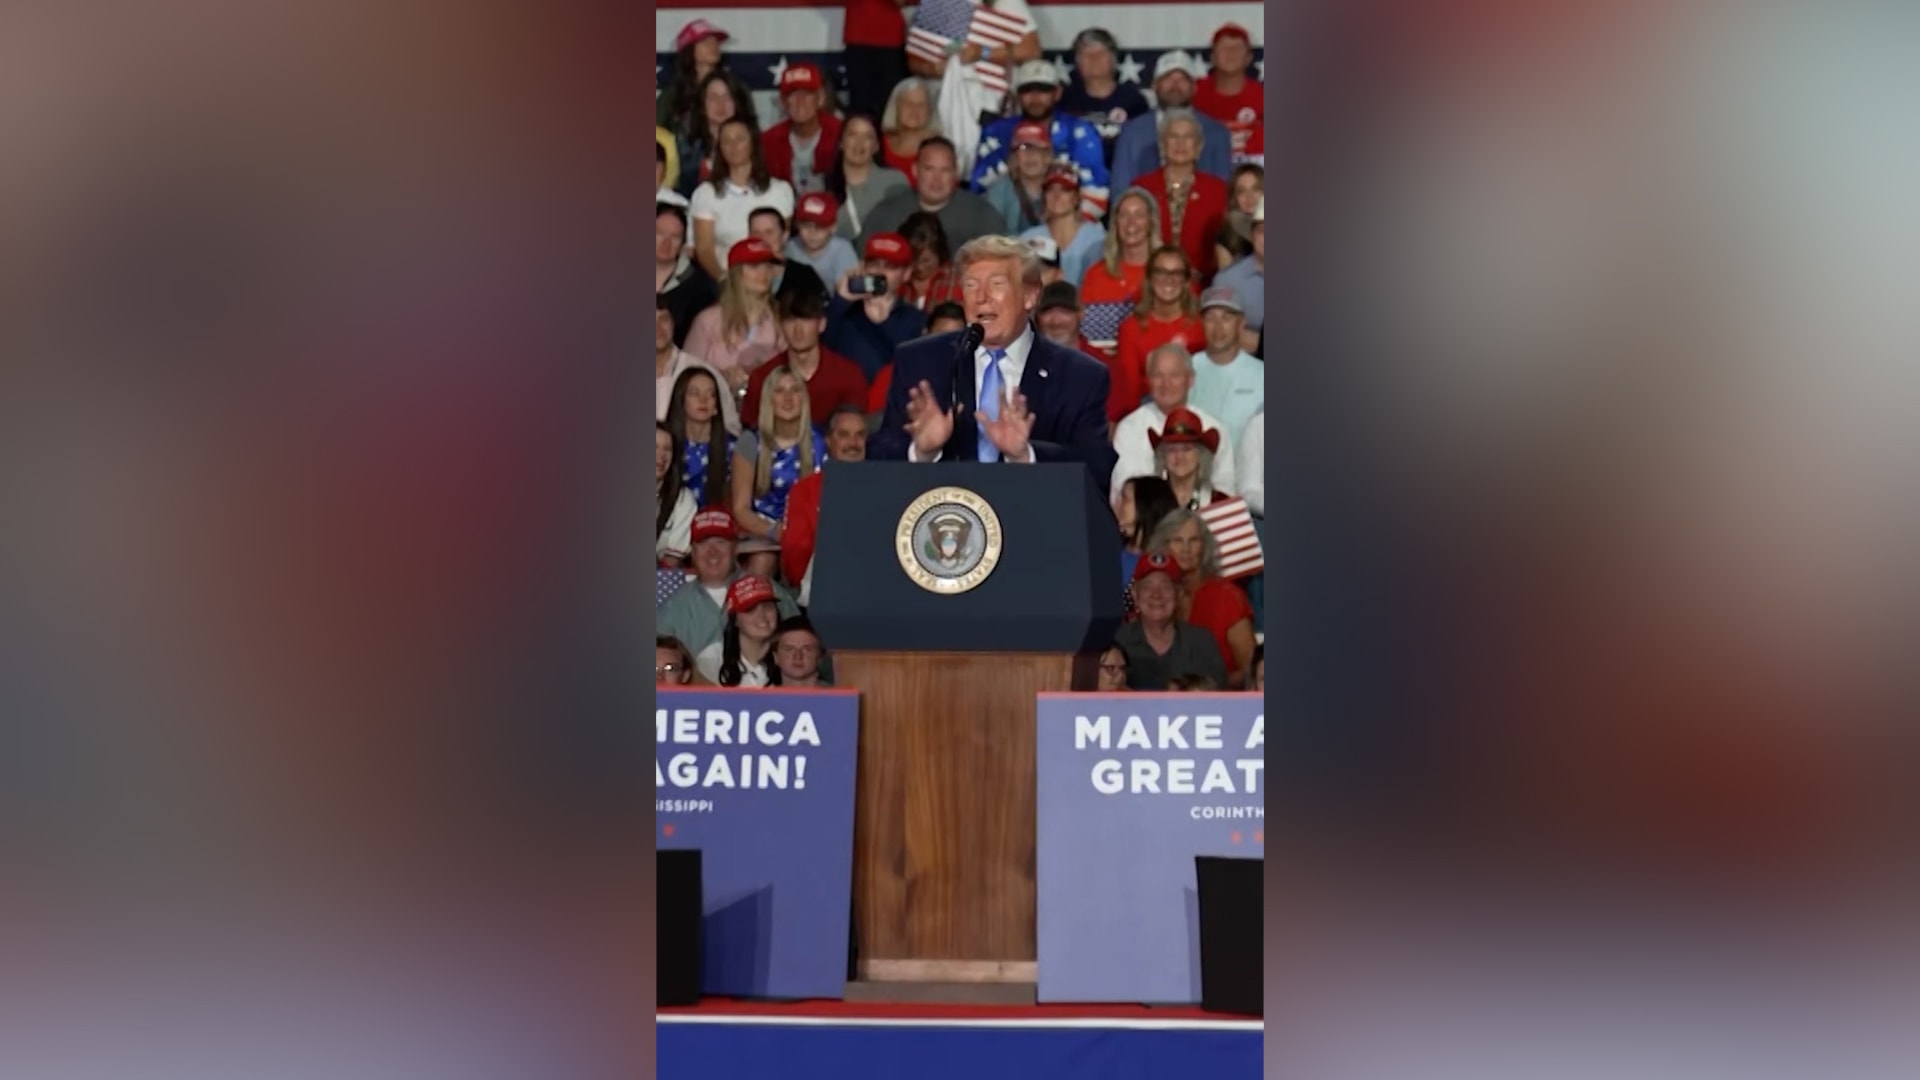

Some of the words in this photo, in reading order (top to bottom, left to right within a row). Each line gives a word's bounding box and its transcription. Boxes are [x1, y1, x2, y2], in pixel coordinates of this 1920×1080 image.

[1074, 715, 1224, 750] MAKE
[1091, 758, 1264, 795] GREAT
[656, 799, 713, 812] ISSIPPI
[1190, 806, 1264, 819] CORINTH
